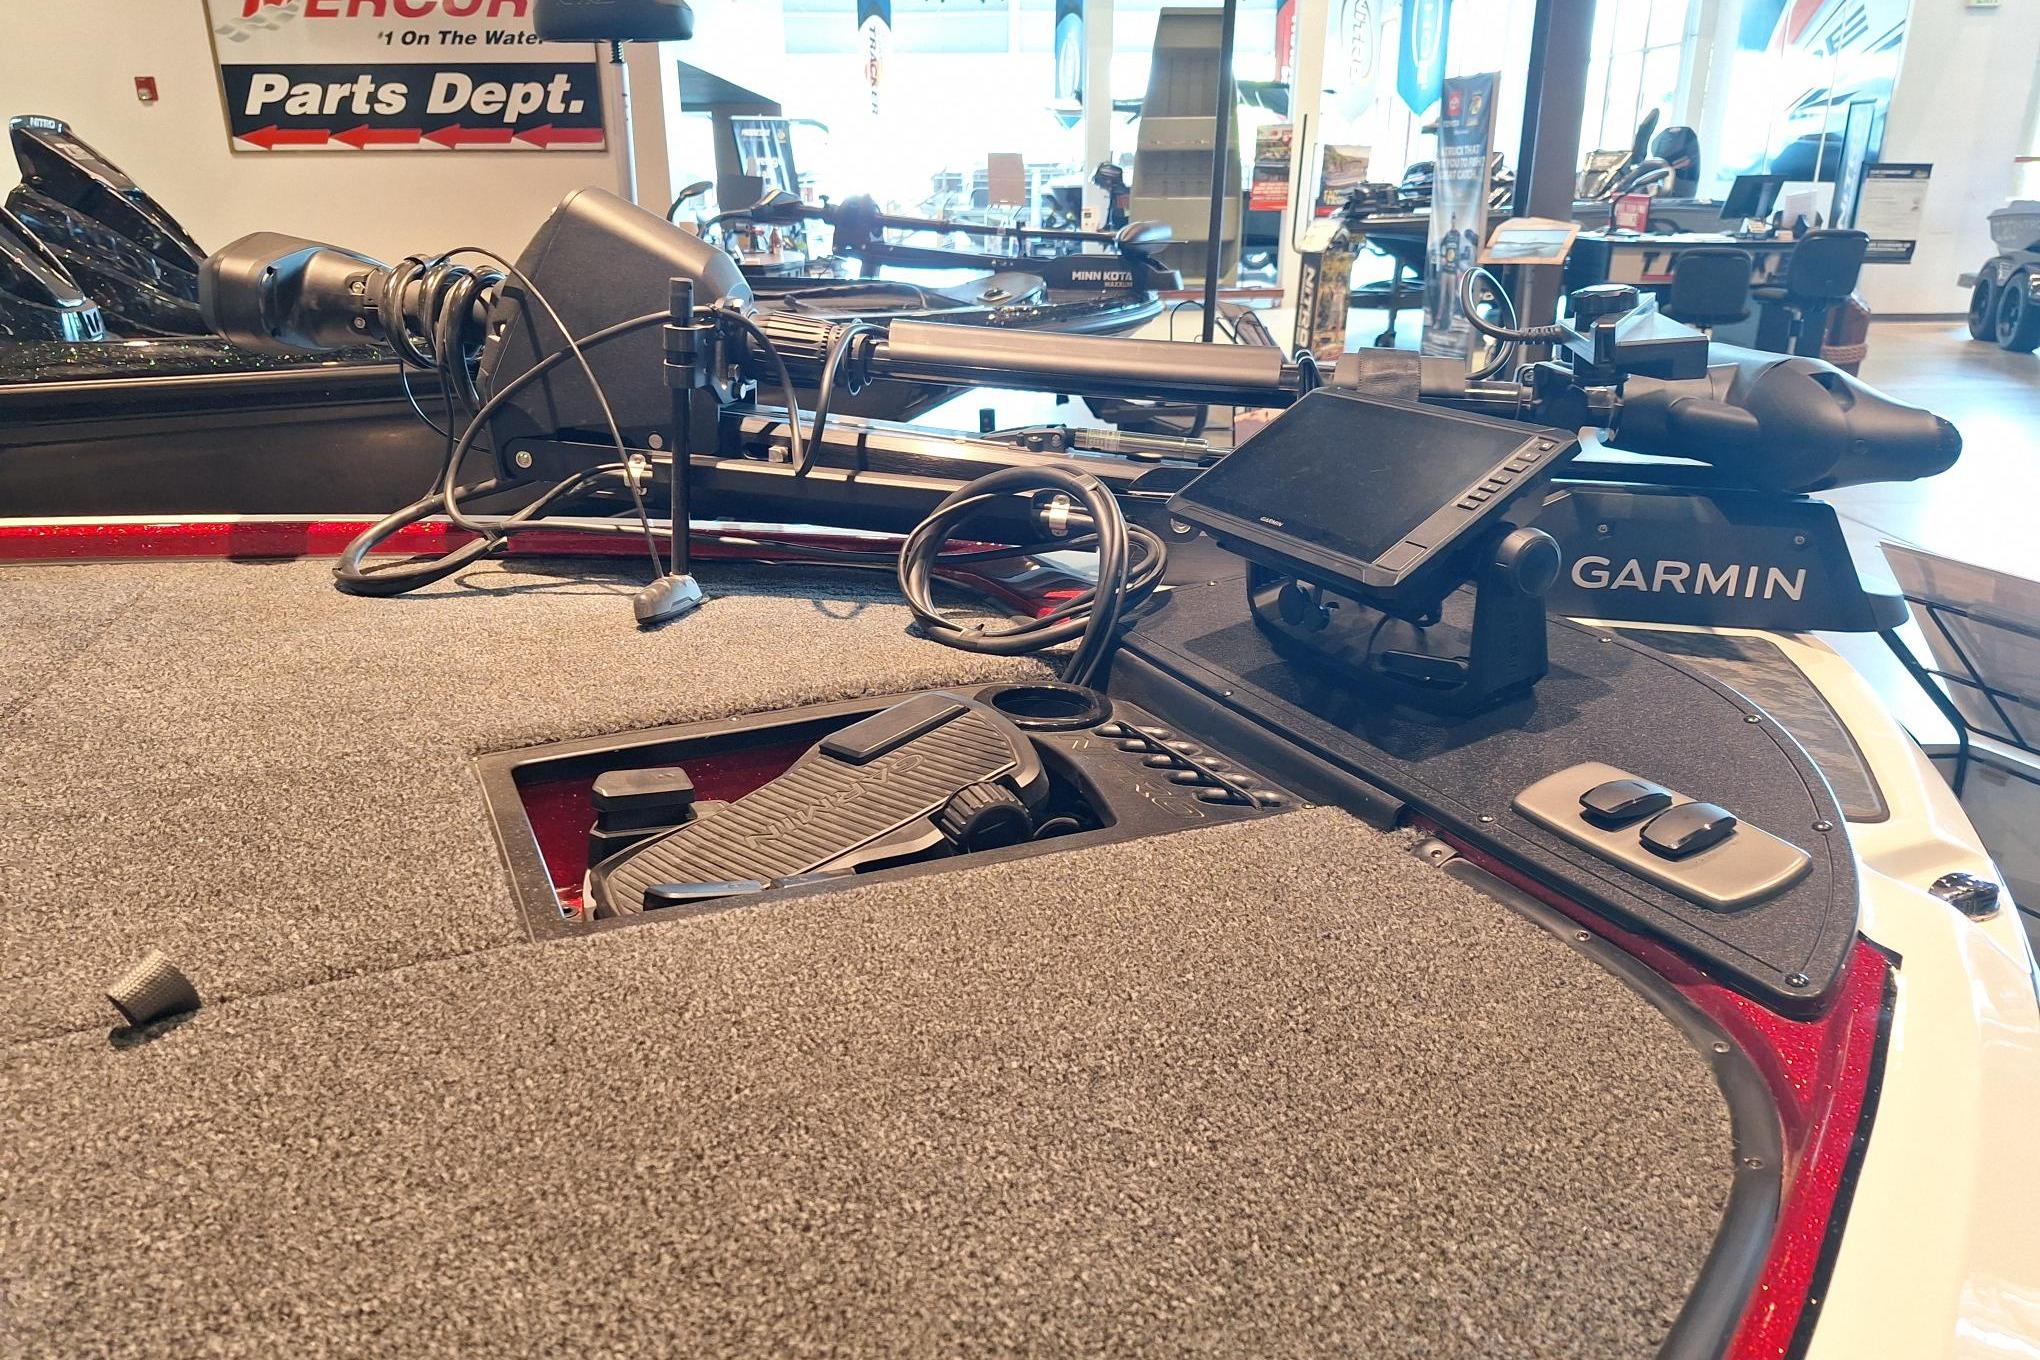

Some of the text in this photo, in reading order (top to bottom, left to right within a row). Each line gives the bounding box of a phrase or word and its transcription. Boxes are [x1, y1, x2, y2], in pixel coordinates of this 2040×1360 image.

[401, 30, 430, 46] On
[438, 30, 477, 46] The
[485, 30, 543, 46] Wate
[244, 72, 585, 124] Parts Dept.
[1071, 270, 1133, 281] MINN KOTA
[1295, 263, 1316, 349] NITRO
[1260, 516, 1284, 527] GARMIN
[1571, 555, 1807, 601] GARMIN
[744, 753, 925, 850] GARMIN
